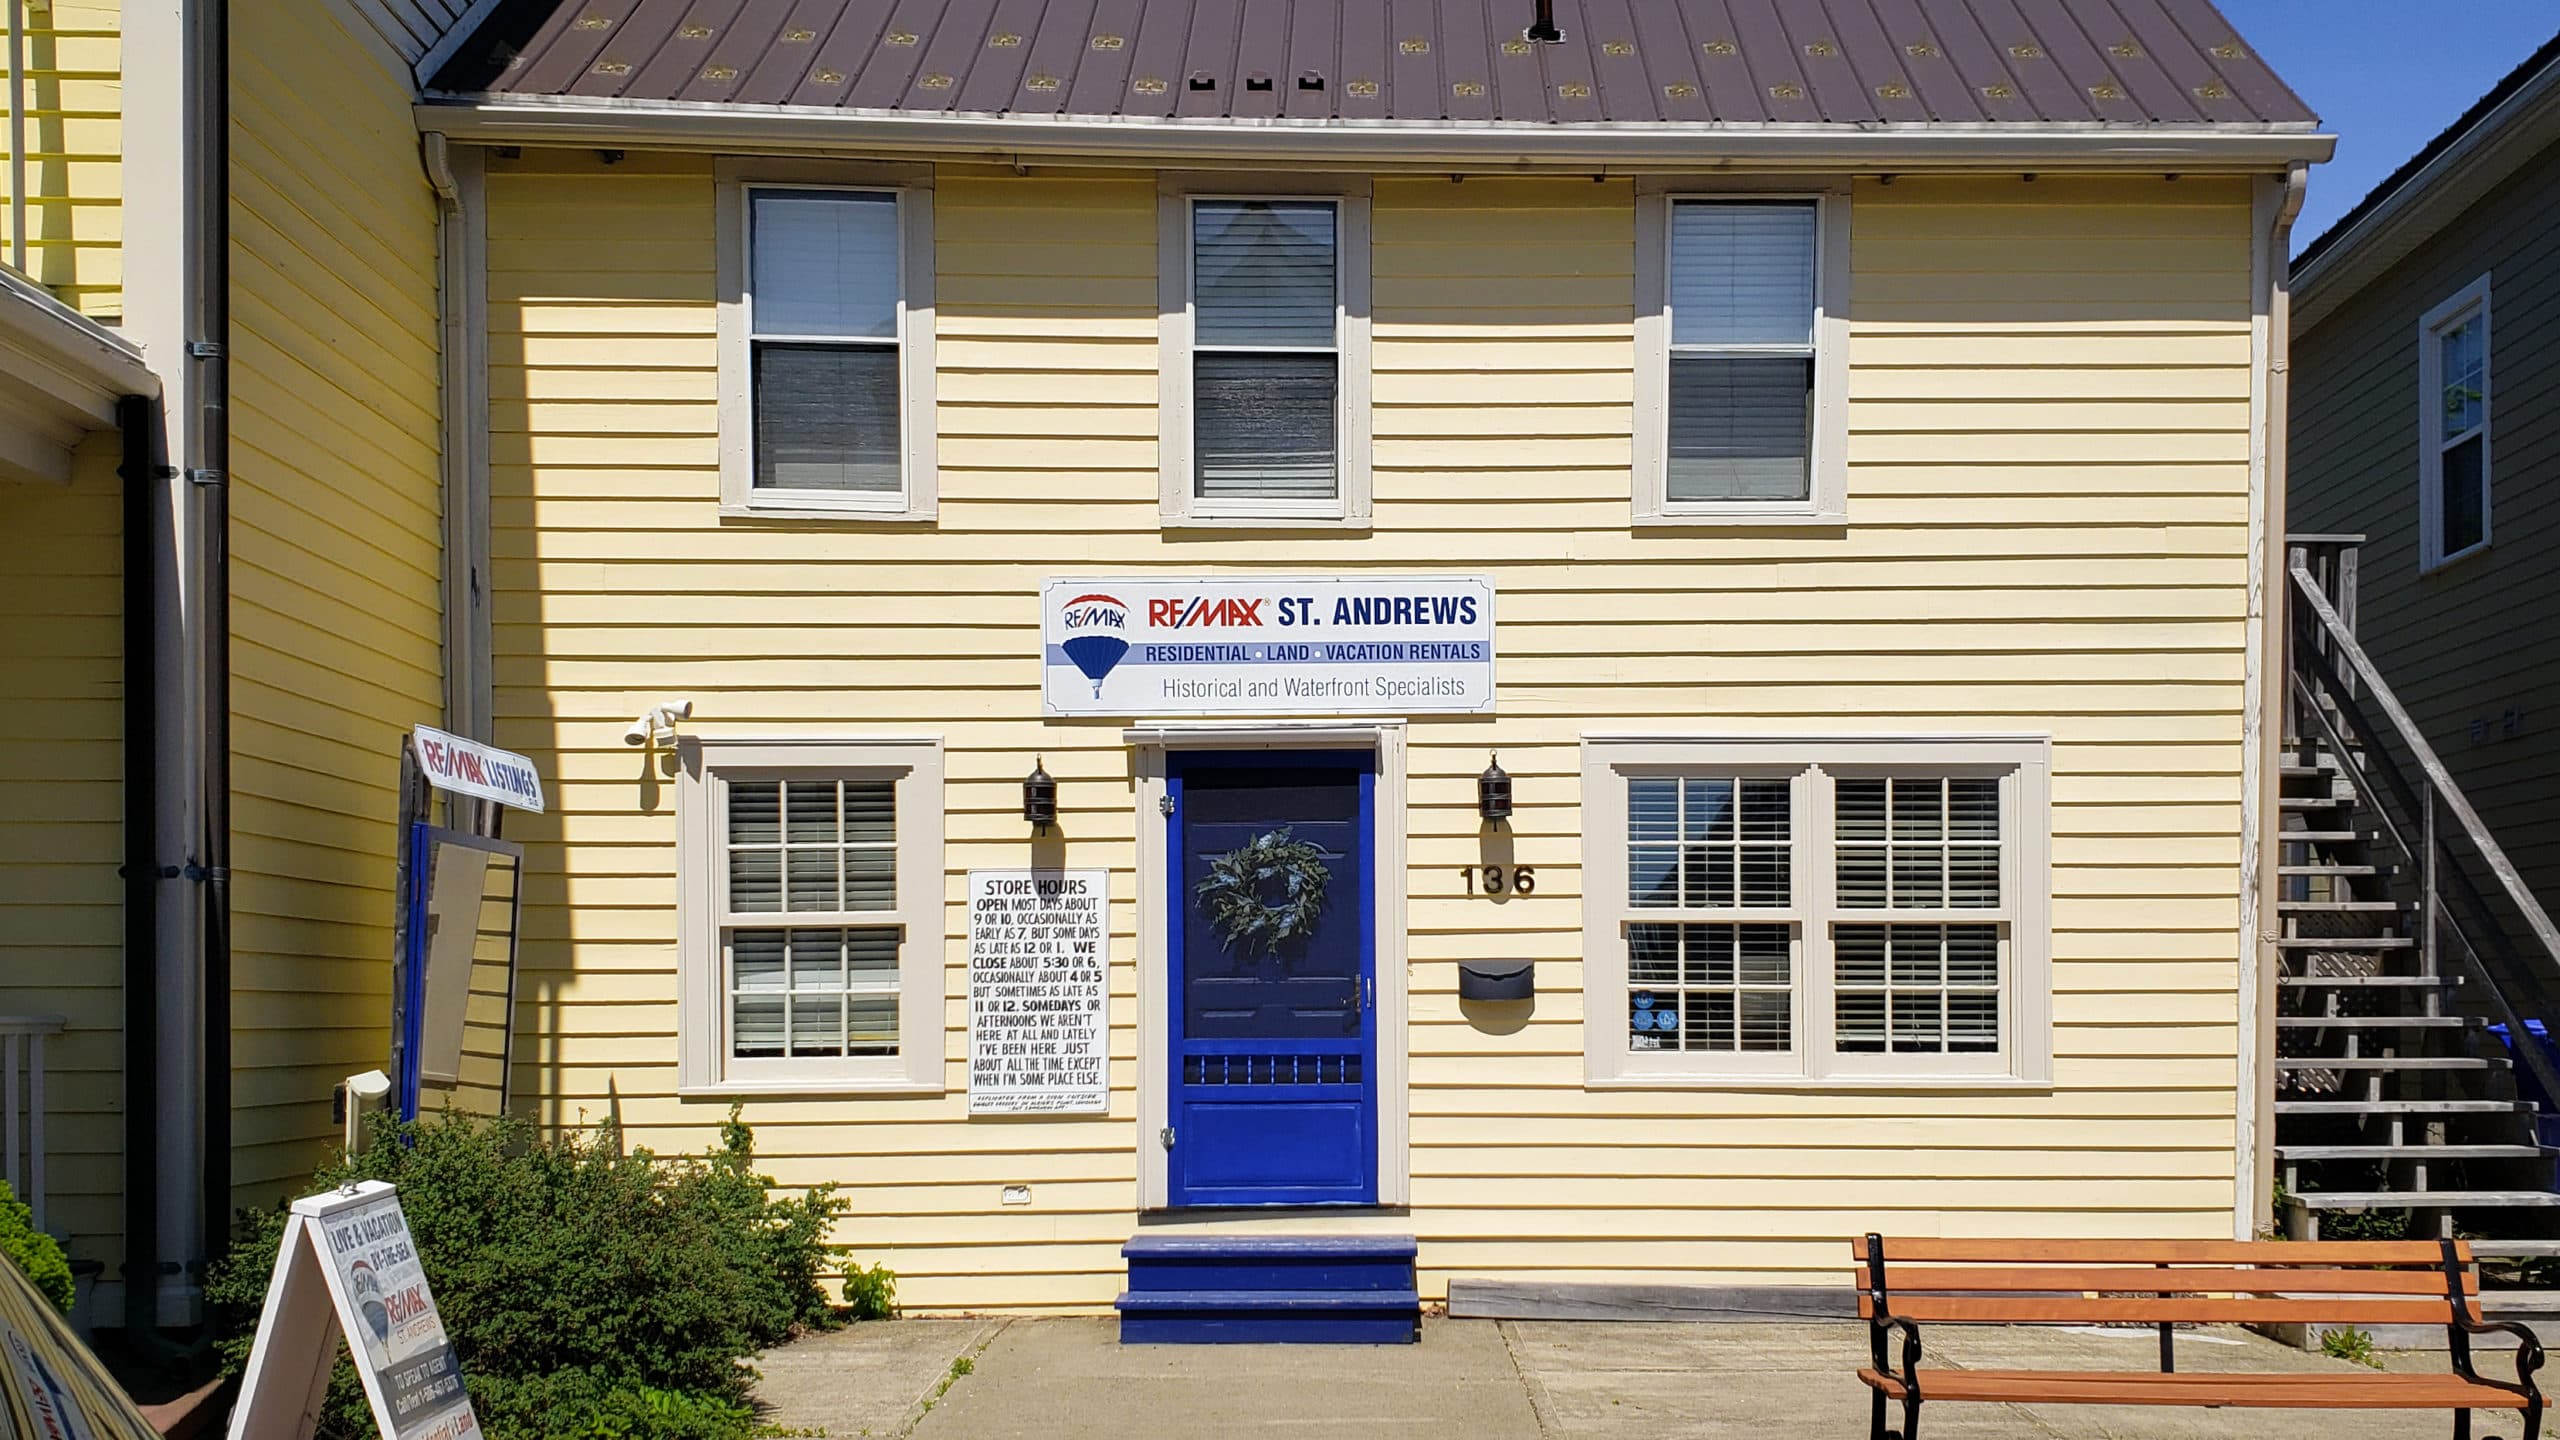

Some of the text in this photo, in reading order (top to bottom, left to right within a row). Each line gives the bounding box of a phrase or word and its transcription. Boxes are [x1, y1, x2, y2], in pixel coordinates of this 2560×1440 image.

[1065, 606, 1125, 630] RE/MAX
[1149, 596, 1477, 629] RE/MAX ST. ANDREWS
[1146, 643, 1480, 662] RESIDENTIAL LAND VACATION RENTALS
[1163, 676, 1465, 700] Historical and Waterfront Specialists
[423, 739, 537, 798] RE/MAX LISTINGS
[985, 880, 1087, 895] STORE HOURS
[977, 898, 1098, 911] OPEN MOST DAYS ABOUT
[974, 913, 982, 925] 9
[985, 914, 997, 925] OR
[1017, 913, 1082, 925] OCCASIONALLY
[1086, 913, 1097, 924] AS
[976, 928, 1001, 940] EARLY
[1004, 928, 1015, 939] AS
[1032, 927, 1050, 939] BUT
[1053, 927, 1076, 939] SOME
[1079, 927, 1100, 938] DAYS
[974, 943, 985, 954] AS
[990, 943, 1008, 954] LATE
[1011, 943, 1021, 953] AS
[1024, 942, 1036, 953] 12
[1040, 942, 1052, 953] OR
[1074, 942, 1096, 953] WE
[973, 957, 1007, 969] CLOSE
[1010, 957, 1039, 968] ABOUT
[1043, 957, 1069, 968] 5:30
[1072, 957, 1084, 968] OR
[973, 971, 1102, 983] OCCASIONALLY ABOUT 4 OR 5
[973, 985, 1098, 998] BUT SOMETIMES AS LATE AS
[988, 1001, 1000, 1012] OR
[1022, 1000, 1081, 1012] SOMEDAYS
[1087, 1000, 1100, 1011] OR
[977, 1014, 1092, 1028] AFTERNOONS WE AREN'T
[976, 1029, 1096, 1040] HERE AT ALL AND LATELY
[980, 1043, 1090, 1055] I'VE BEEN HERE JUST
[974, 1057, 1101, 1071] ABOUT ALL THE TIME EXCEPT
[974, 1072, 1102, 1086] WHEN I'M SOME PLACE ELSE.
[331, 1210, 404, 1254] LIVE & VACATION
[370, 1240, 412, 1272] BY-THE-SEA
[384, 1283, 428, 1325] RE/MAX
